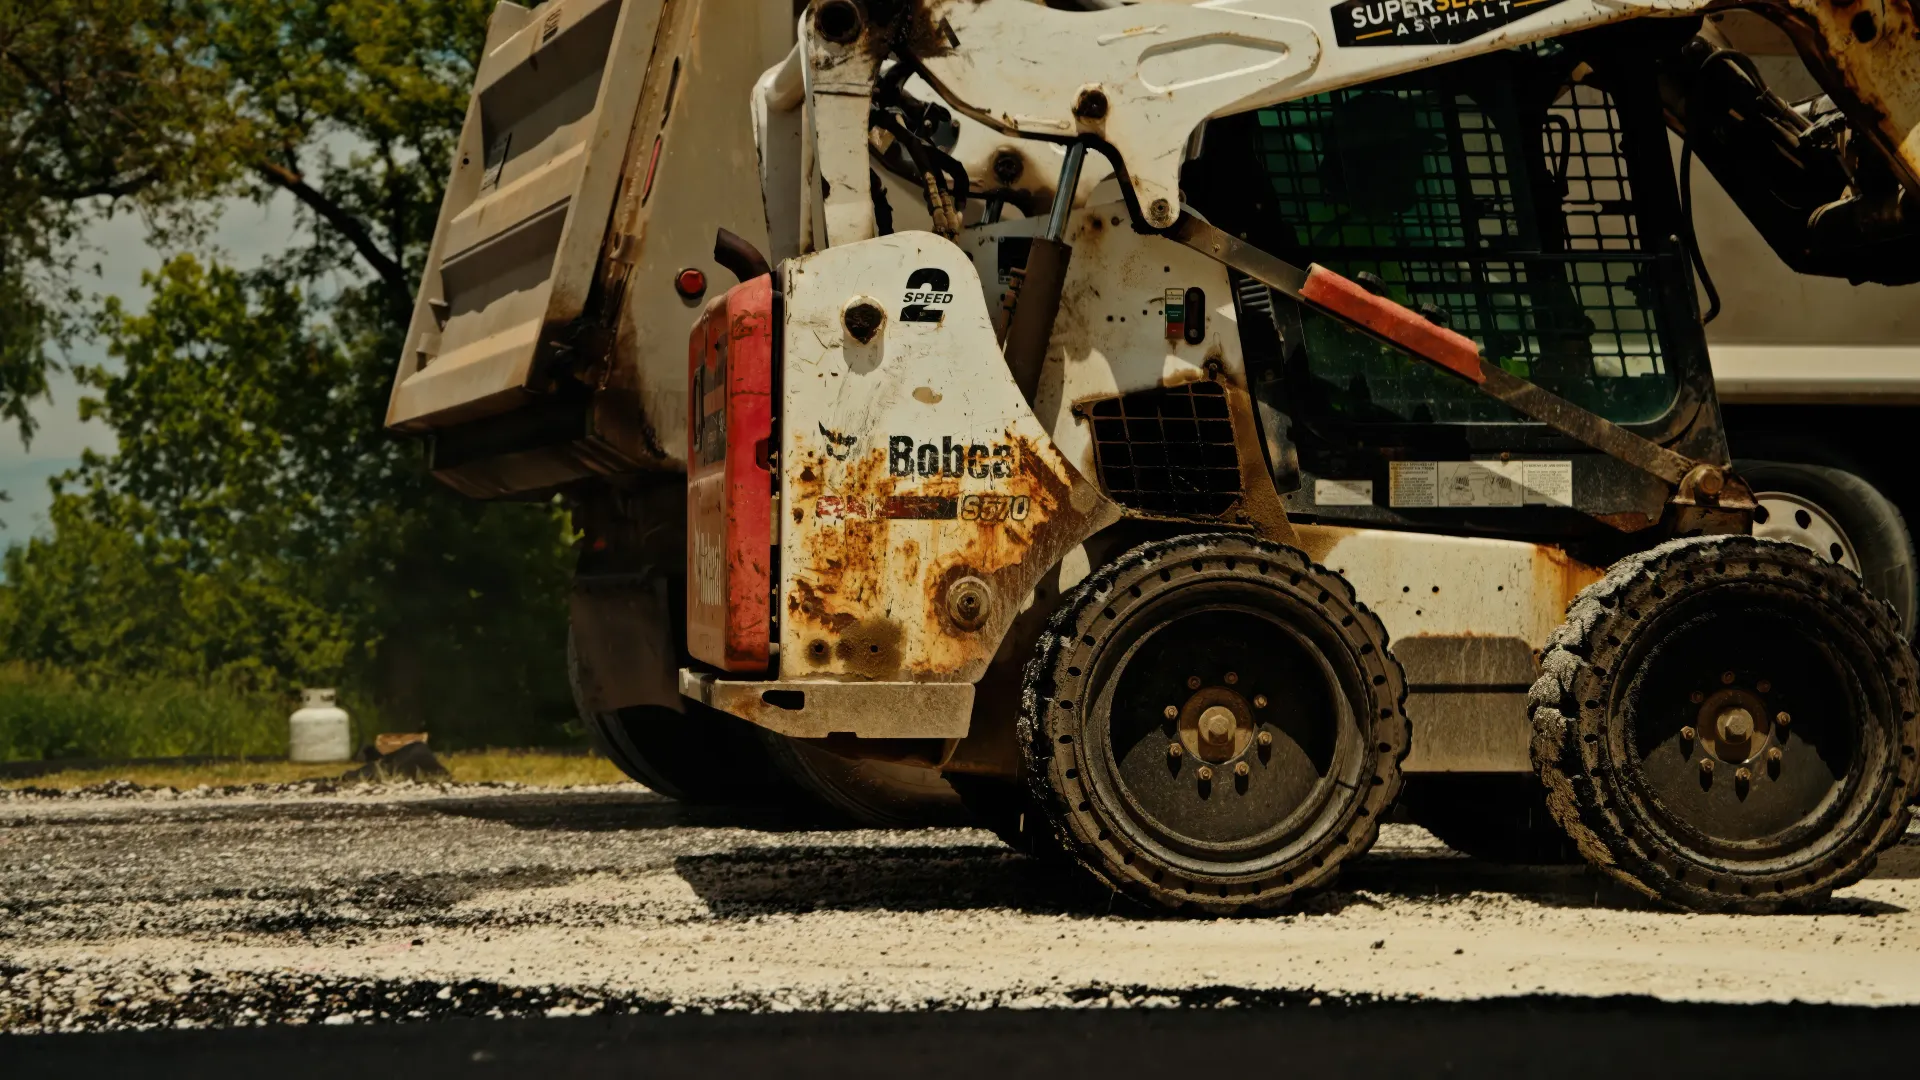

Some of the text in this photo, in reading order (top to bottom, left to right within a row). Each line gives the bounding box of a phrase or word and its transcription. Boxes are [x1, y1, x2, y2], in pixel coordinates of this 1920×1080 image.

[1351, 0, 1494, 28] SUPERS
[1396, 1, 1510, 36] ASPHALT
[899, 267, 953, 322] 2 SPEED
[889, 435, 1016, 479] Bobca
[961, 494, 1030, 522] S570
